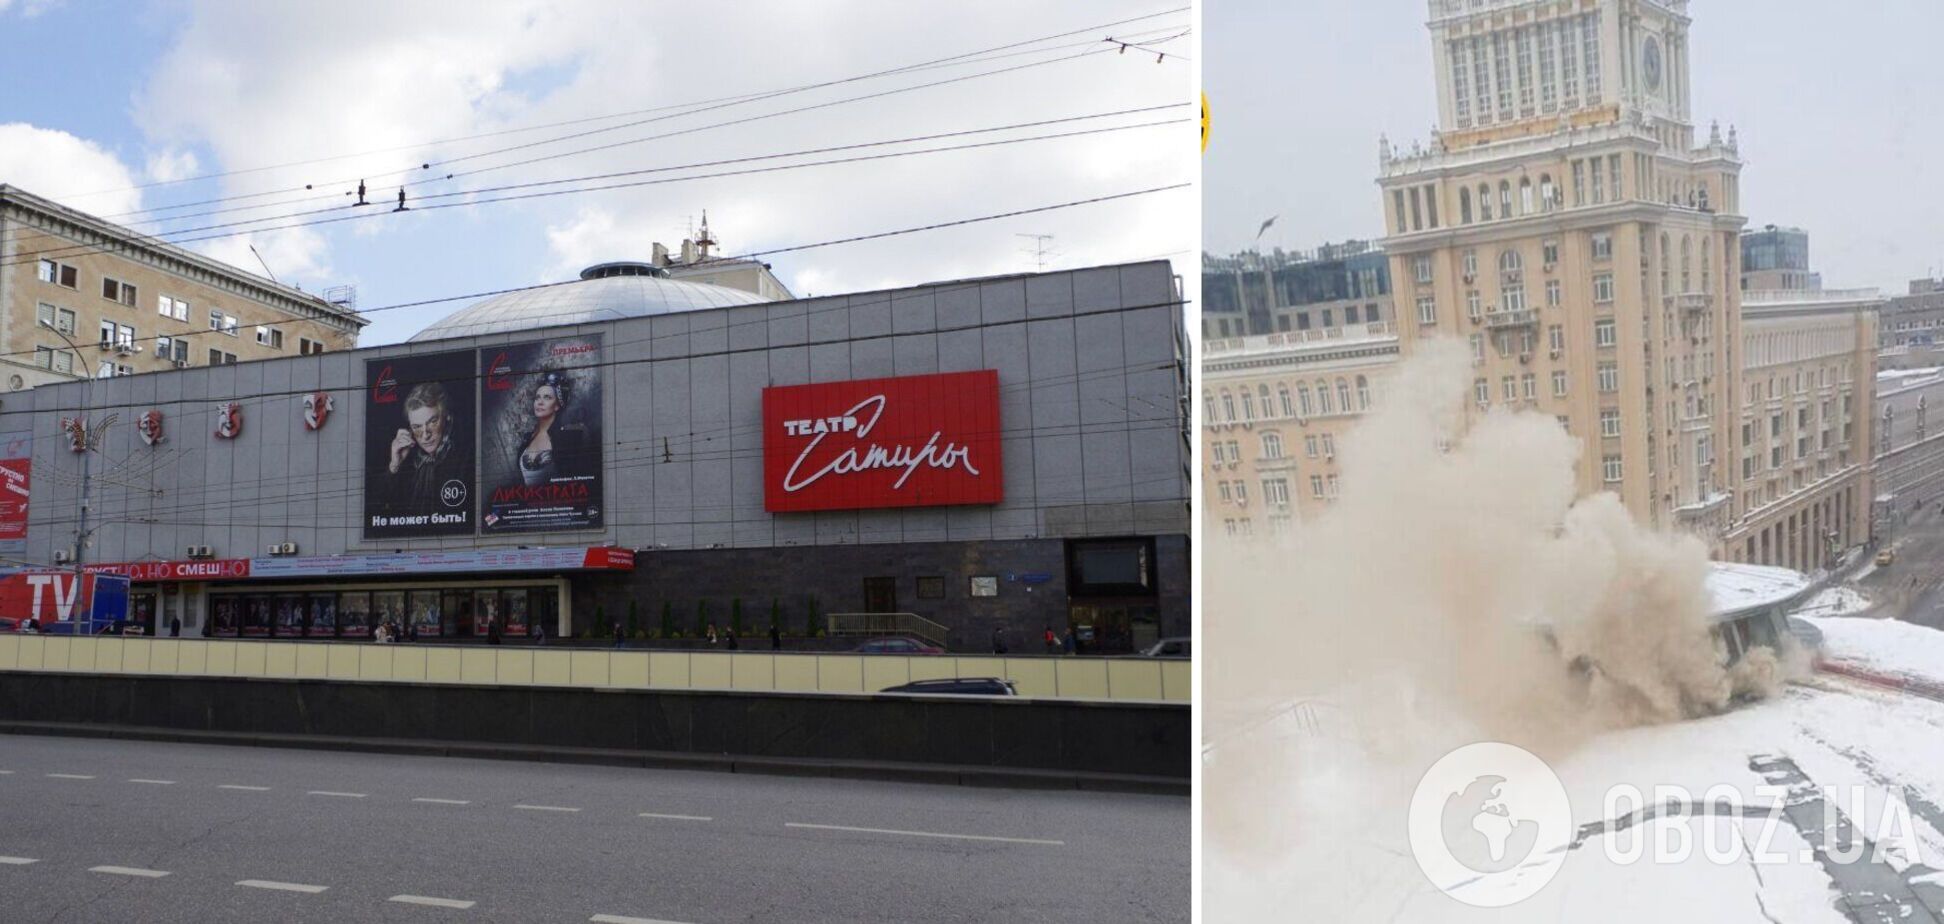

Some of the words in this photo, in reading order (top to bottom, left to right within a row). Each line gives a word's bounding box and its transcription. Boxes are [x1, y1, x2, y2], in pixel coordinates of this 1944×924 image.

[784, 416, 857, 436] ТЕАТР
[783, 394, 979, 492] Сатиры
[444, 487, 465, 499] 80+
[372, 515, 387, 527] Не
[389, 515, 429, 526] может
[431, 511, 467, 524] быть!
[177, 560, 246, 576] СМЕШНО
[27, 575, 79, 621] TV
